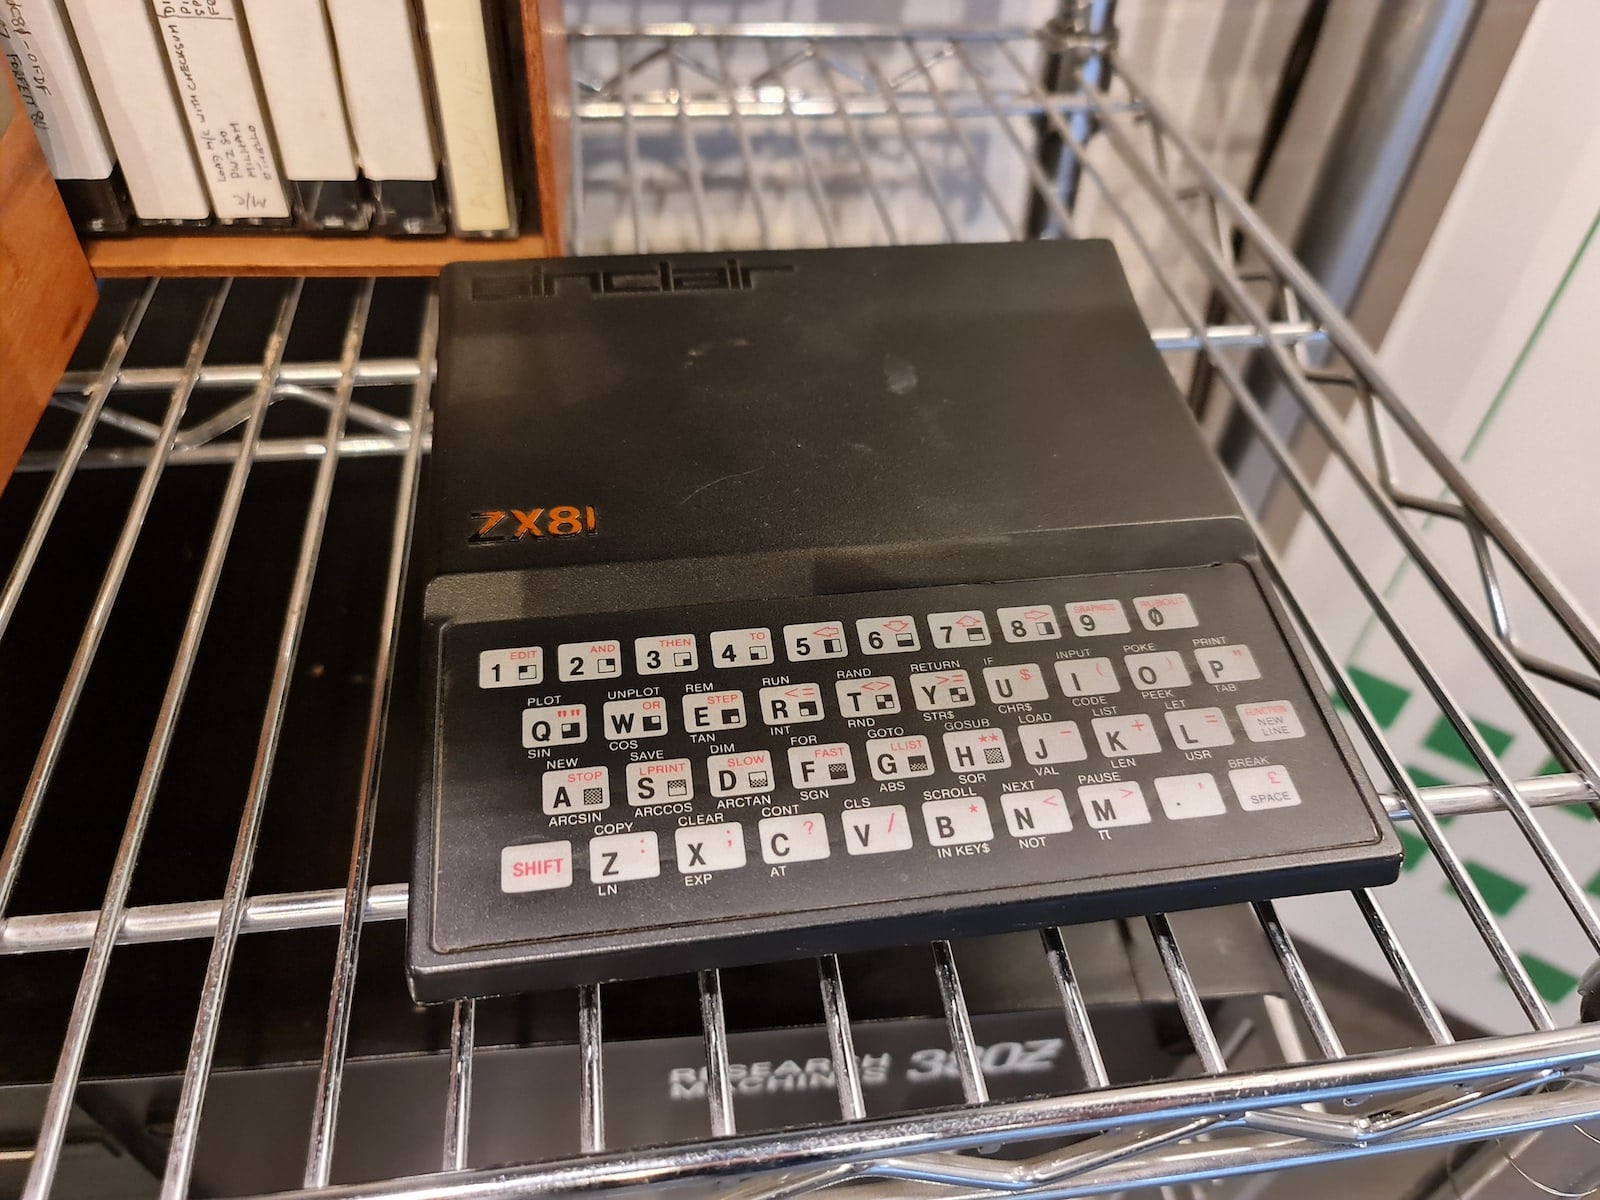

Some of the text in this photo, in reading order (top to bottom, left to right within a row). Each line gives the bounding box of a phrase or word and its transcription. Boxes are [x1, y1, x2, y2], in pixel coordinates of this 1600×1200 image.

[168, 25, 196, 91] CHECKSUM
[471, 259, 796, 300] sinclair
[468, 505, 598, 547] ZX81
[1010, 620, 1027, 638] 8
[1080, 614, 1095, 632] 9
[750, 631, 766, 641] TO
[868, 632, 884, 649] 6
[939, 626, 953, 644] 7
[658, 638, 691, 648] THEN
[796, 638, 811, 655] 5
[1123, 643, 1156, 652] POKE
[1192, 637, 1227, 647] PRINT
[510, 650, 537, 661] EDIT
[590, 644, 615, 654] AND
[721, 644, 737, 662] 4
[1056, 648, 1090, 660] INPUT
[647, 650, 661, 669] 3
[983, 656, 994, 666] IF
[491, 664, 501, 682] 1
[570, 657, 584, 676] 2
[910, 660, 960, 673] RETURN
[1208, 660, 1224, 678] P
[836, 668, 872, 679] RAND
[1138, 666, 1157, 685] O
[685, 682, 714, 693] REM
[762, 675, 790, 687] RUN
[1071, 673, 1082, 691] I
[607, 687, 660, 700] UNPLOT
[995, 679, 1013, 698] U
[1141, 690, 1174, 700] PEEK
[1215, 684, 1237, 693] TAB
[527, 695, 562, 707] PLOT
[707, 694, 738, 705] STEP
[847, 692, 862, 712] T
[921, 686, 937, 705] Y
[1072, 696, 1107, 707] CODE
[642, 700, 661, 711] OR
[772, 700, 789, 720] R
[997, 703, 1032, 715] CHR$
[1092, 706, 1118, 717] LIST
[1164, 700, 1186, 710] LET
[695, 706, 709, 727] E
[847, 718, 875, 728] RND
[922, 711, 955, 722] STR$
[1017, 712, 1052, 724] LOAD
[1257, 716, 1283, 726] NEW
[611, 713, 635, 734] W
[944, 718, 990, 731] GOSUB
[531, 721, 551, 742] Q
[770, 726, 791, 736] INT
[867, 727, 904, 738] GOTO
[1179, 724, 1199, 744] L
[1262, 726, 1290, 736] LINE
[690, 733, 716, 744] TAN
[790, 735, 817, 746] FOR
[1106, 731, 1127, 751] K
[609, 740, 638, 751] COS
[710, 744, 735, 754] DIM
[890, 740, 923, 752] LLIST
[1035, 738, 1048, 760] J
[527, 748, 551, 760] SIN
[630, 750, 664, 762] SAVE
[814, 747, 845, 758] FAST
[955, 745, 975, 767] H
[1185, 750, 1212, 761] USR
[546, 758, 579, 770] NEW
[727, 755, 765, 768] SLOW
[877, 753, 897, 775] G
[1110, 758, 1136, 769] LEN
[1228, 757, 1271, 769] BREAK
[639, 763, 686, 776] LPRINT
[801, 760, 815, 782] F
[1034, 767, 1059, 777] VAL
[567, 771, 603, 783] STOP
[719, 770, 737, 791] D
[959, 774, 986, 784] SQR
[1078, 772, 1121, 784] PAUSE
[637, 777, 655, 799] S
[879, 782, 906, 792] ABS
[1002, 781, 1036, 792] NEXT
[552, 786, 572, 809] A
[800, 790, 829, 801] SGN
[923, 787, 977, 801] SCROLL
[1250, 791, 1292, 805] SPACE
[716, 795, 771, 809] ARCTAN
[844, 797, 870, 809] CLS
[634, 803, 693, 818] ARCCOS
[761, 805, 799, 817] CONT
[1091, 799, 1117, 822] M
[548, 812, 602, 827] ARCSIN
[678, 813, 724, 827] CLEAR
[1013, 807, 1035, 830] N
[594, 822, 634, 835] COPY
[935, 815, 955, 838] B
[853, 824, 871, 847] V
[770, 833, 791, 857] C
[1018, 837, 1046, 849] NOT
[687, 843, 706, 867] X
[512, 858, 564, 877] SHIFT
[602, 852, 620, 876] Z
[769, 866, 787, 877] AT
[684, 874, 713, 887] EXP
[598, 884, 618, 897] LN
[670, 1051, 892, 1084] RSEARH
[670, 1068, 889, 1100] MCHINS
